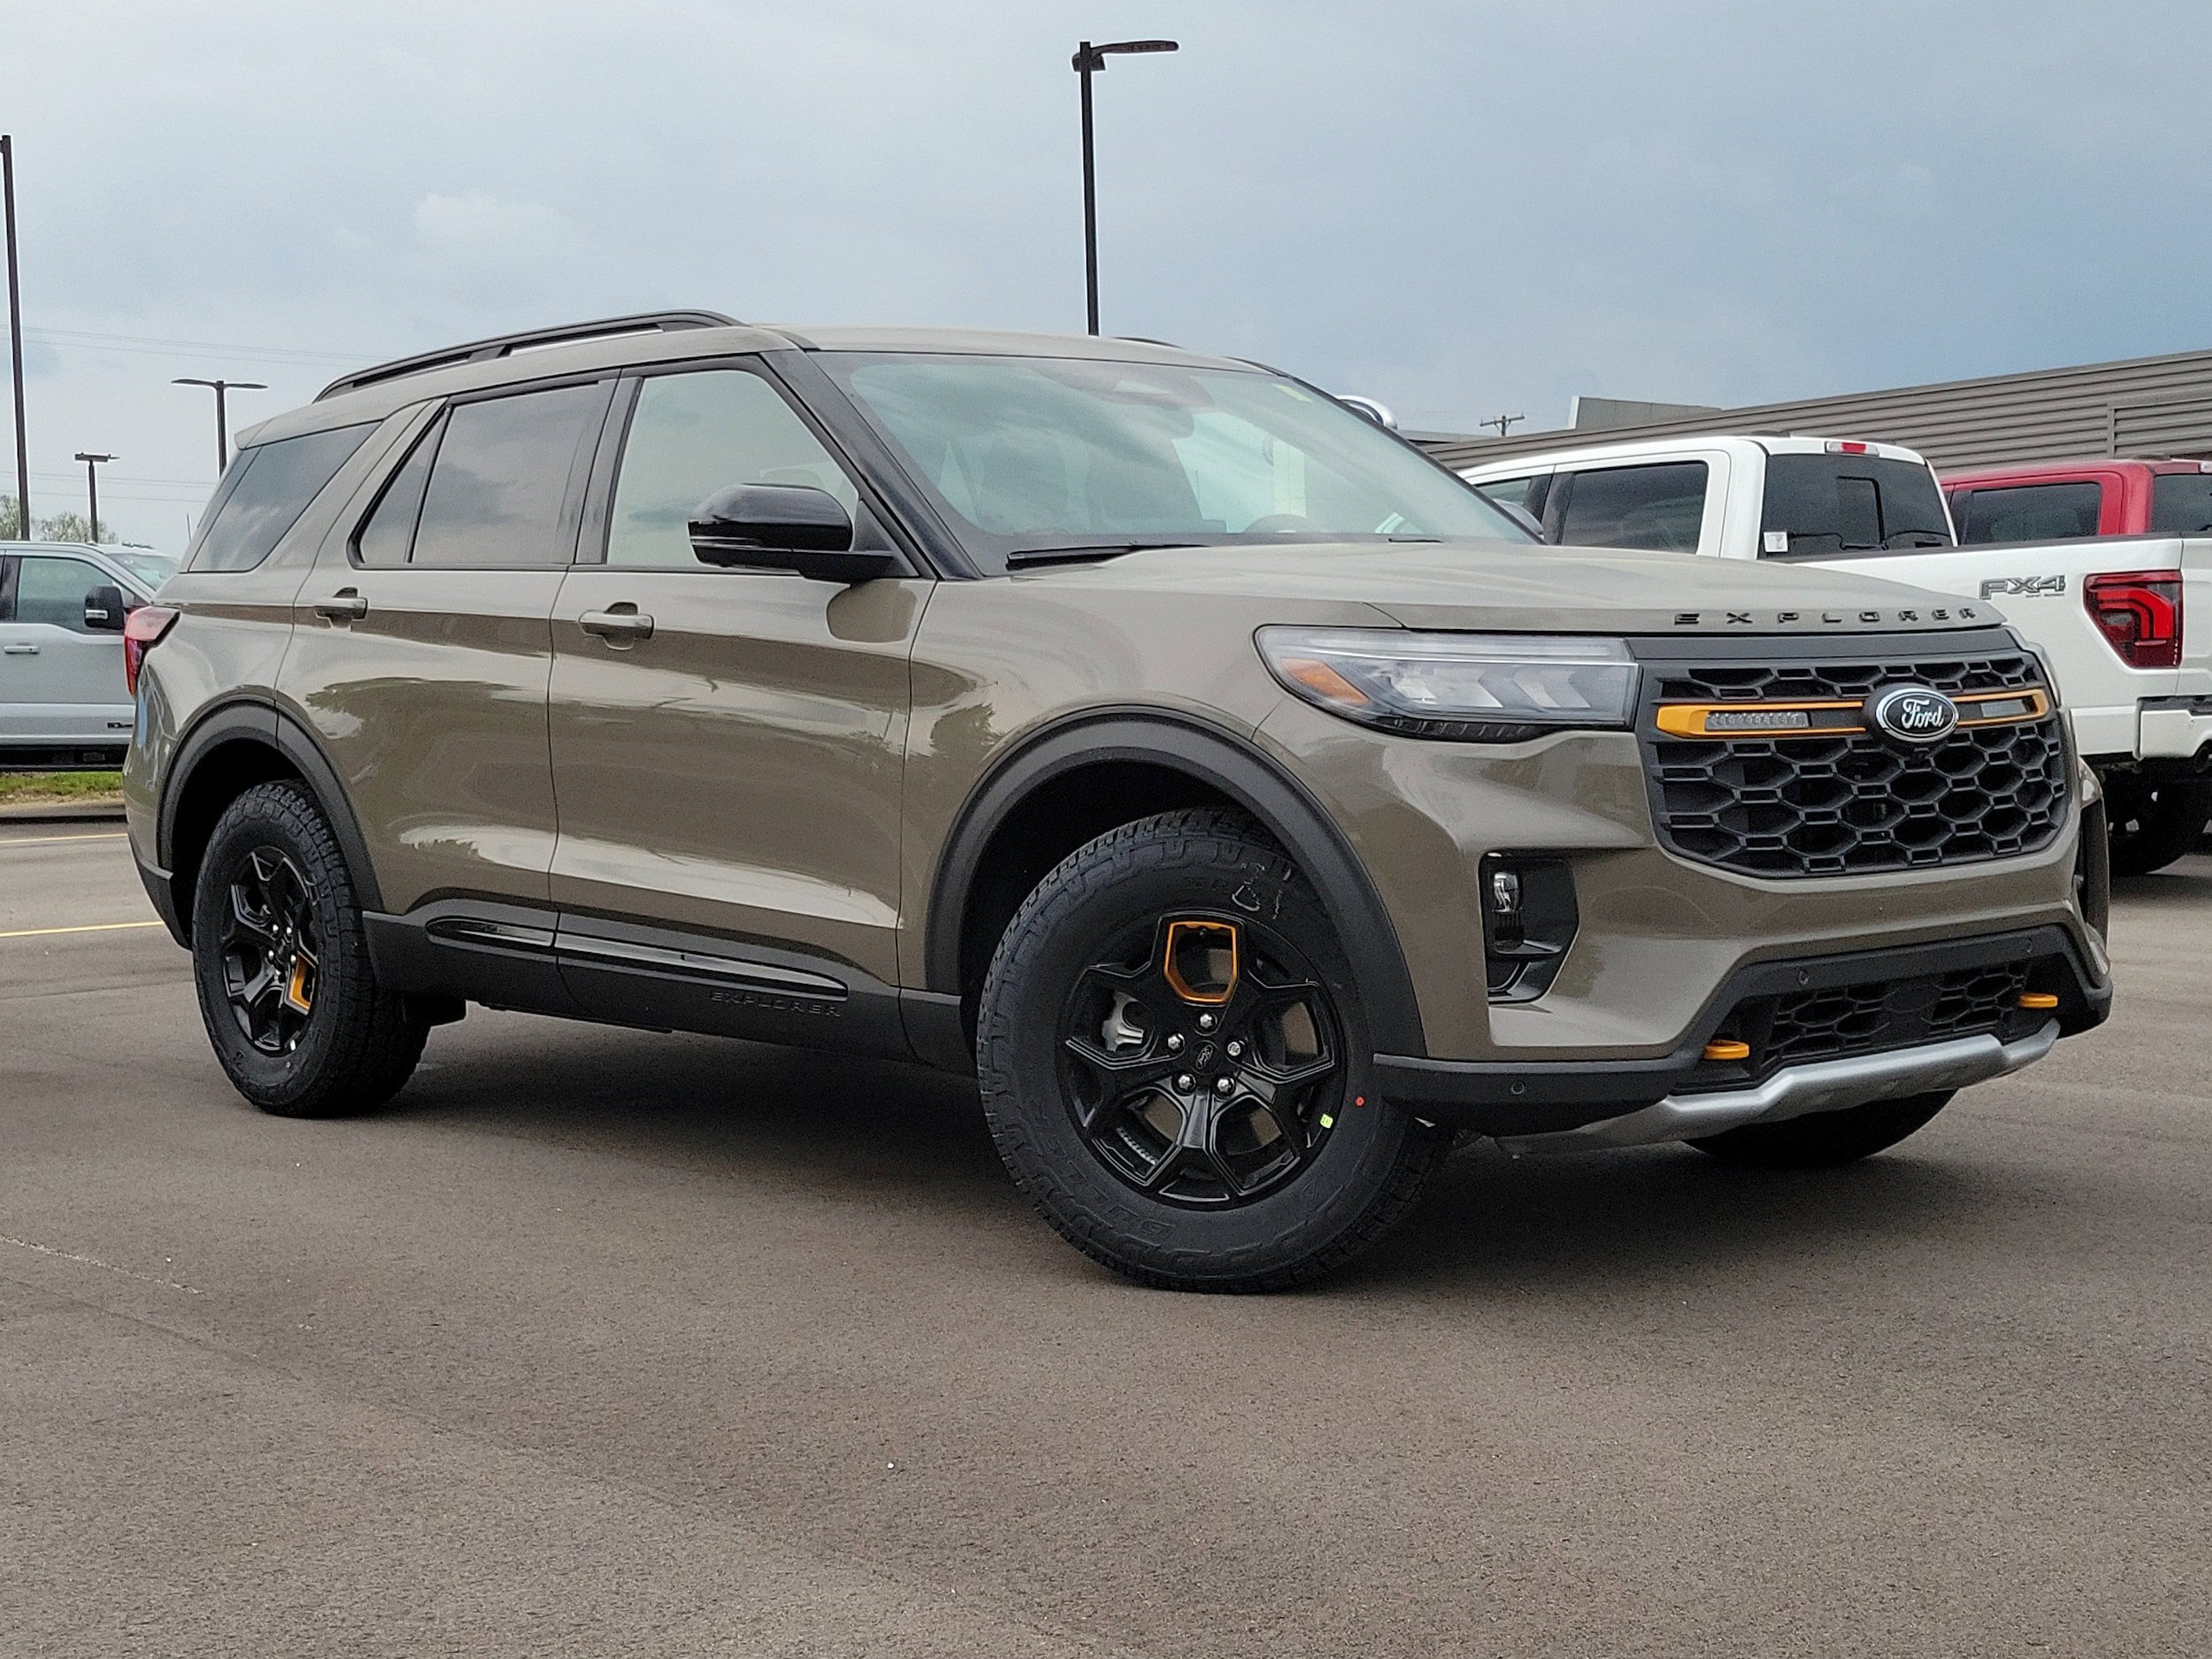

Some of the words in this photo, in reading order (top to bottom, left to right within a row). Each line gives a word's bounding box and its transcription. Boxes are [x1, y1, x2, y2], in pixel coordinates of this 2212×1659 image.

[1979, 575, 2066, 600] FX4
[1674, 608, 1976, 626] EXPLORER
[1901, 698, 1944, 729] Ford
[710, 991, 841, 1018] EXPLORER
